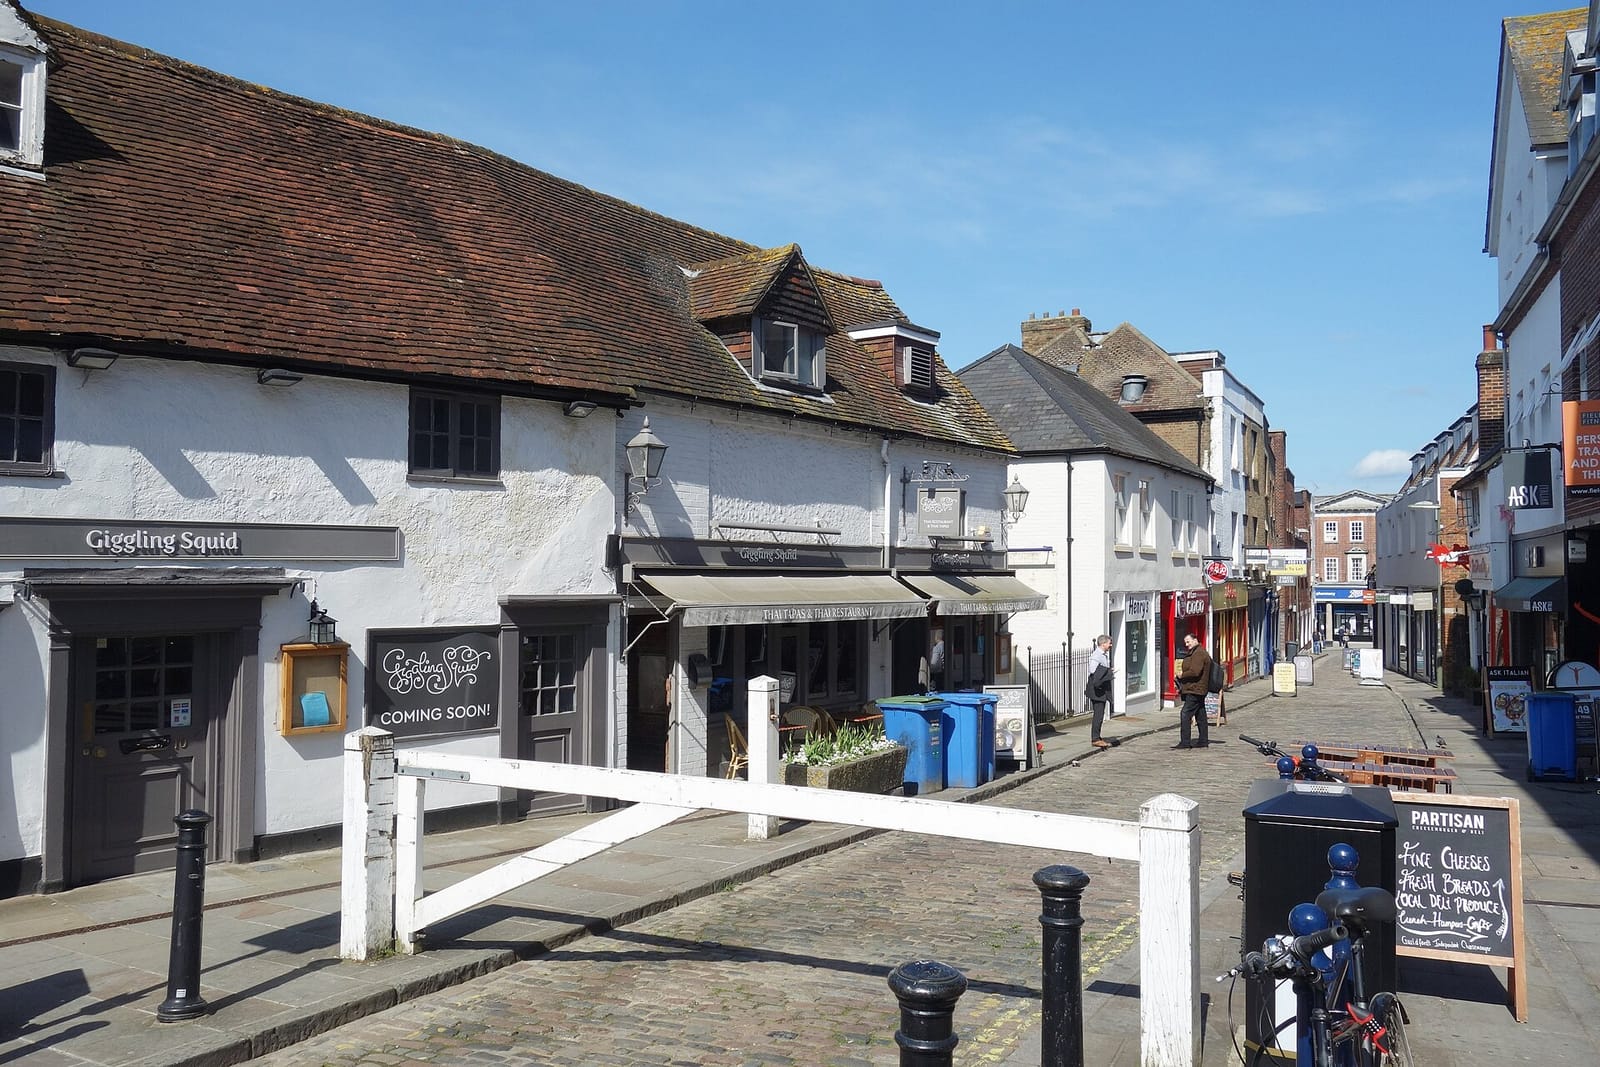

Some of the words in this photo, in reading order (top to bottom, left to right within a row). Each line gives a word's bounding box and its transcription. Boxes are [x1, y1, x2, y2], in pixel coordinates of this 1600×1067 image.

[1571, 459, 1599, 468] AND
[1508, 485, 1540, 507] ASK
[86, 530, 175, 553] Giggling
[181, 532, 239, 554] Squid
[740, 547, 774, 562] Giggling
[774, 548, 797, 562] Squid
[763, 609, 782, 620] THAI
[784, 608, 806, 619] TAPAS
[814, 608, 831, 619] THAI
[831, 606, 874, 618] RESTAURANT
[1128, 596, 1149, 618] Henry's
[1532, 601, 1548, 612] ASK
[383, 648, 447, 694] Giggling
[436, 645, 492, 690] Squid
[381, 707, 442, 725] COMING
[446, 703, 491, 720] SOON!
[1575, 704, 1590, 715] 49
[1411, 810, 1485, 829] PARTISAN
[1398, 841, 1432, 869] FINE
[1441, 846, 1491, 872] CHEESES
[1399, 869, 1436, 893] FRESH
[1442, 873, 1491, 897] BREADS
[1454, 896, 1501, 915] PRODUCE
